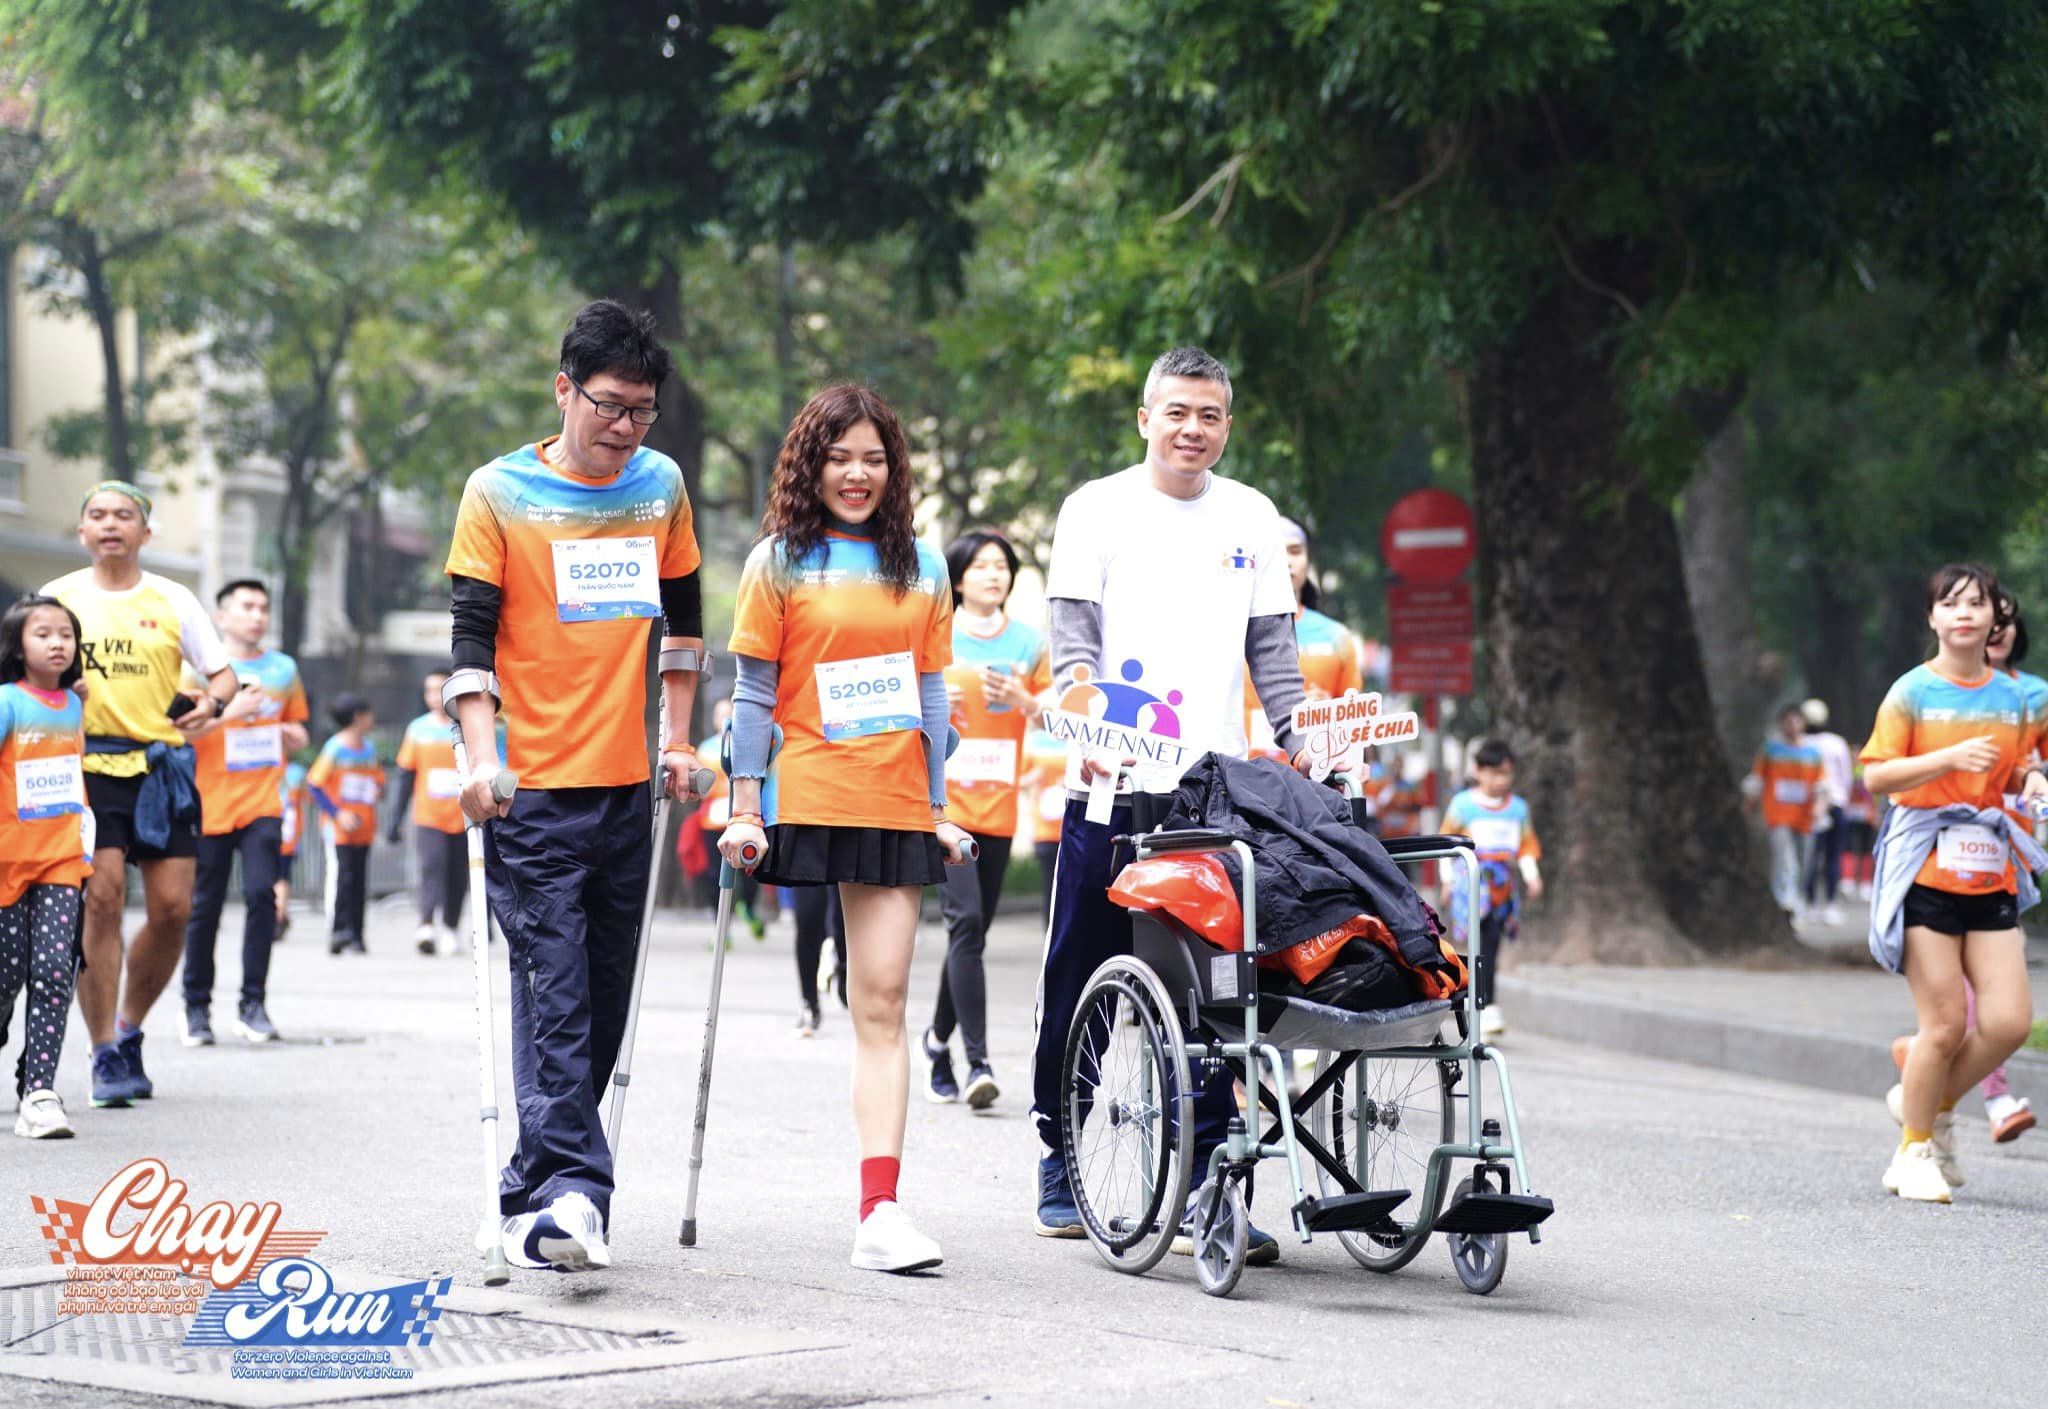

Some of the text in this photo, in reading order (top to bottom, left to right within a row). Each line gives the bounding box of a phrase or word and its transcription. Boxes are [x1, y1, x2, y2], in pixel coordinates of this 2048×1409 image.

[569, 562, 641, 580] 52070
[829, 677, 901, 700] 52069
[1297, 705, 1331, 729] BÌNH
[1046, 712, 1189, 766] VNMENNET
[1374, 719, 1414, 739] CHIA
[26, 773, 73, 790] 50628
